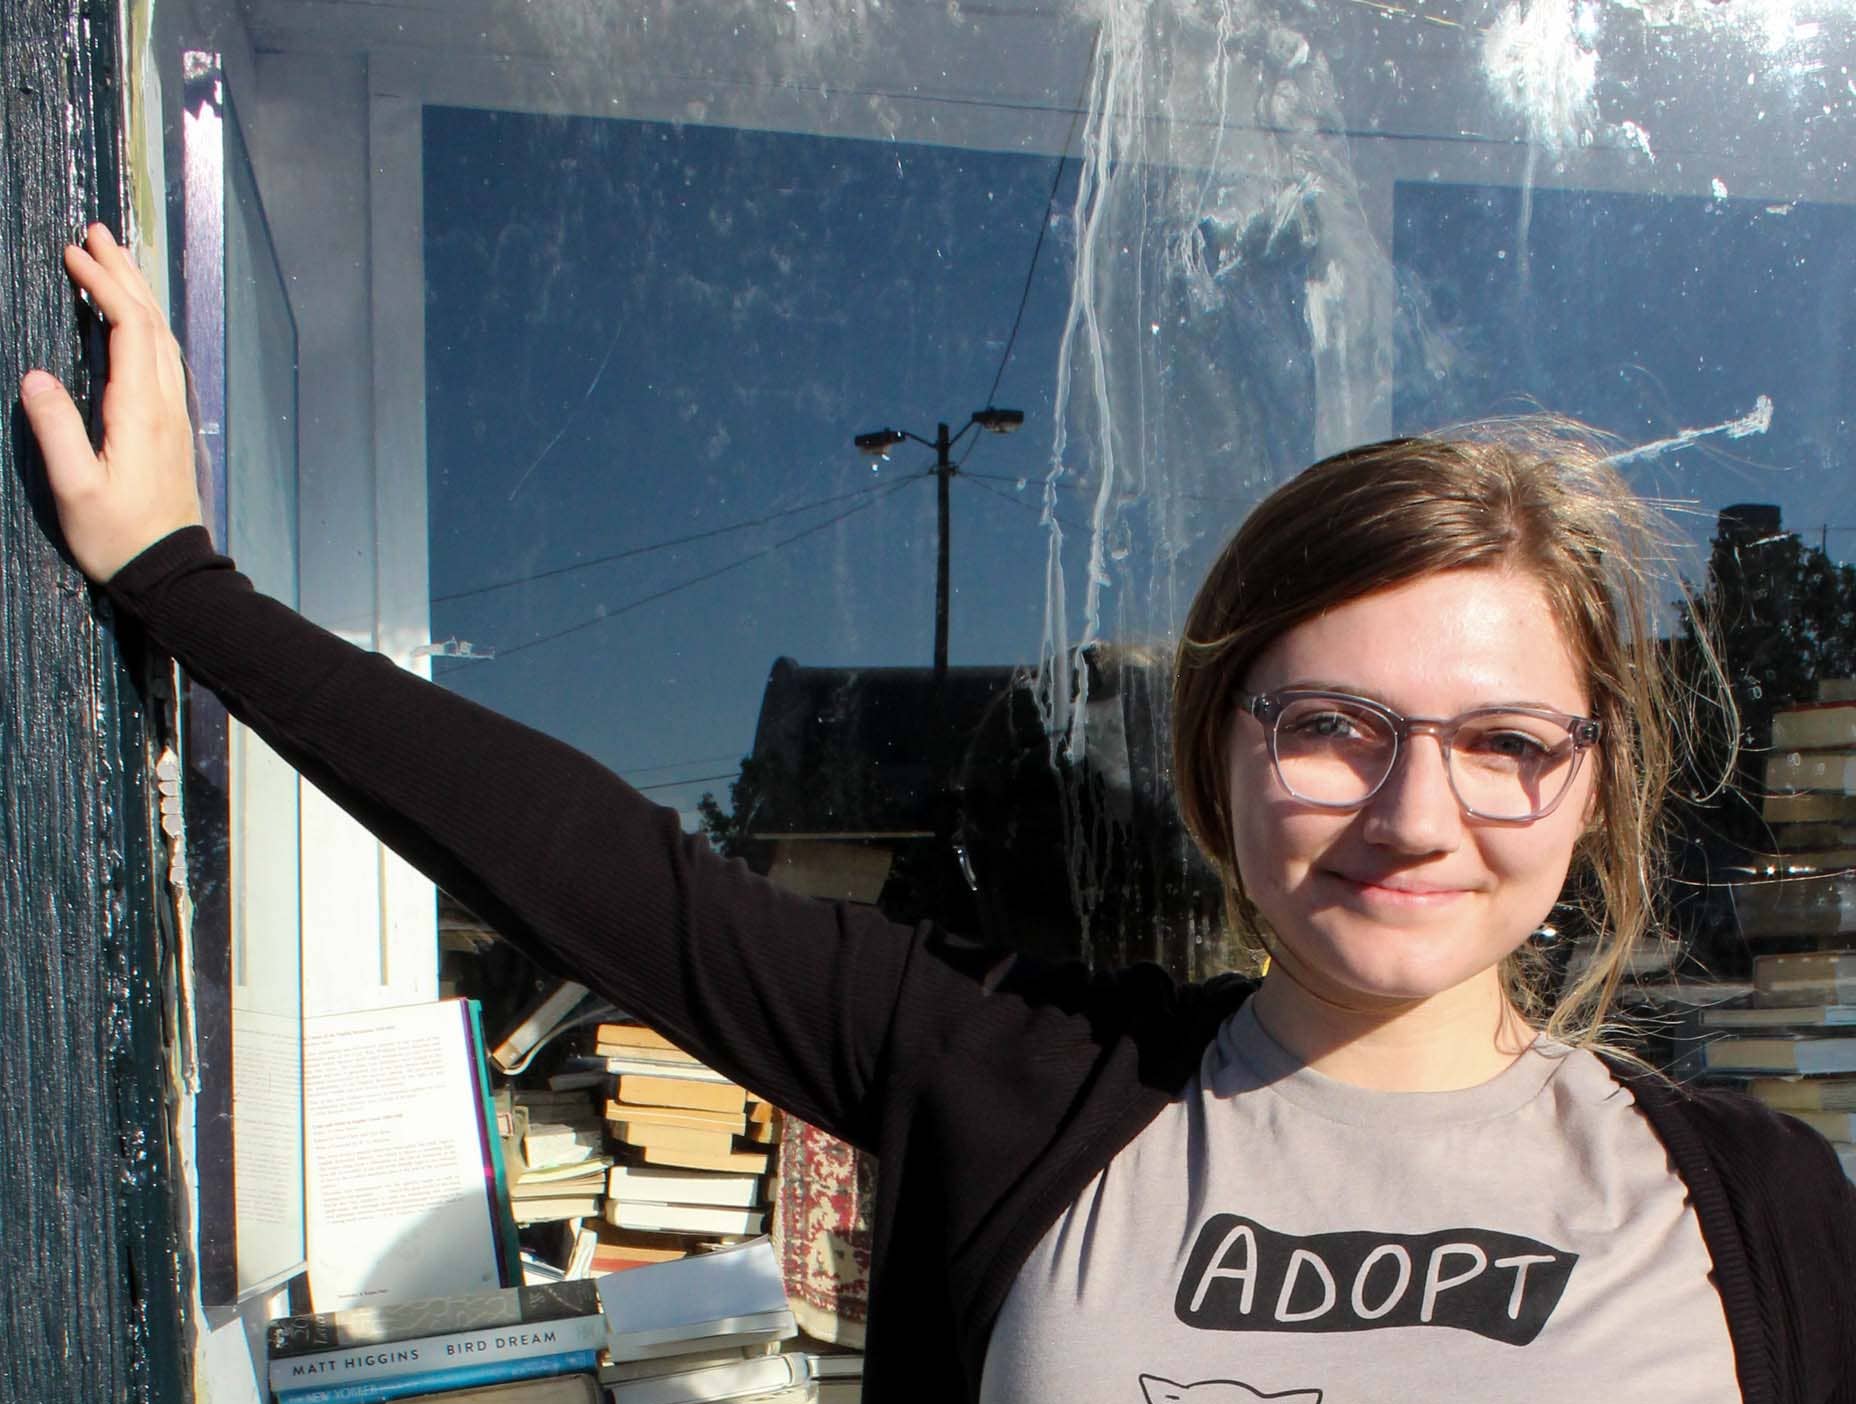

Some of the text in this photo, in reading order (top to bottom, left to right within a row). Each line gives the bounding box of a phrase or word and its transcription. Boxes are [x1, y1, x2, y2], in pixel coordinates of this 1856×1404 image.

[1189, 1225, 1556, 1322] ADOPT
[292, 1331, 557, 1377] MATT HIGGINS BIRD DREAM
